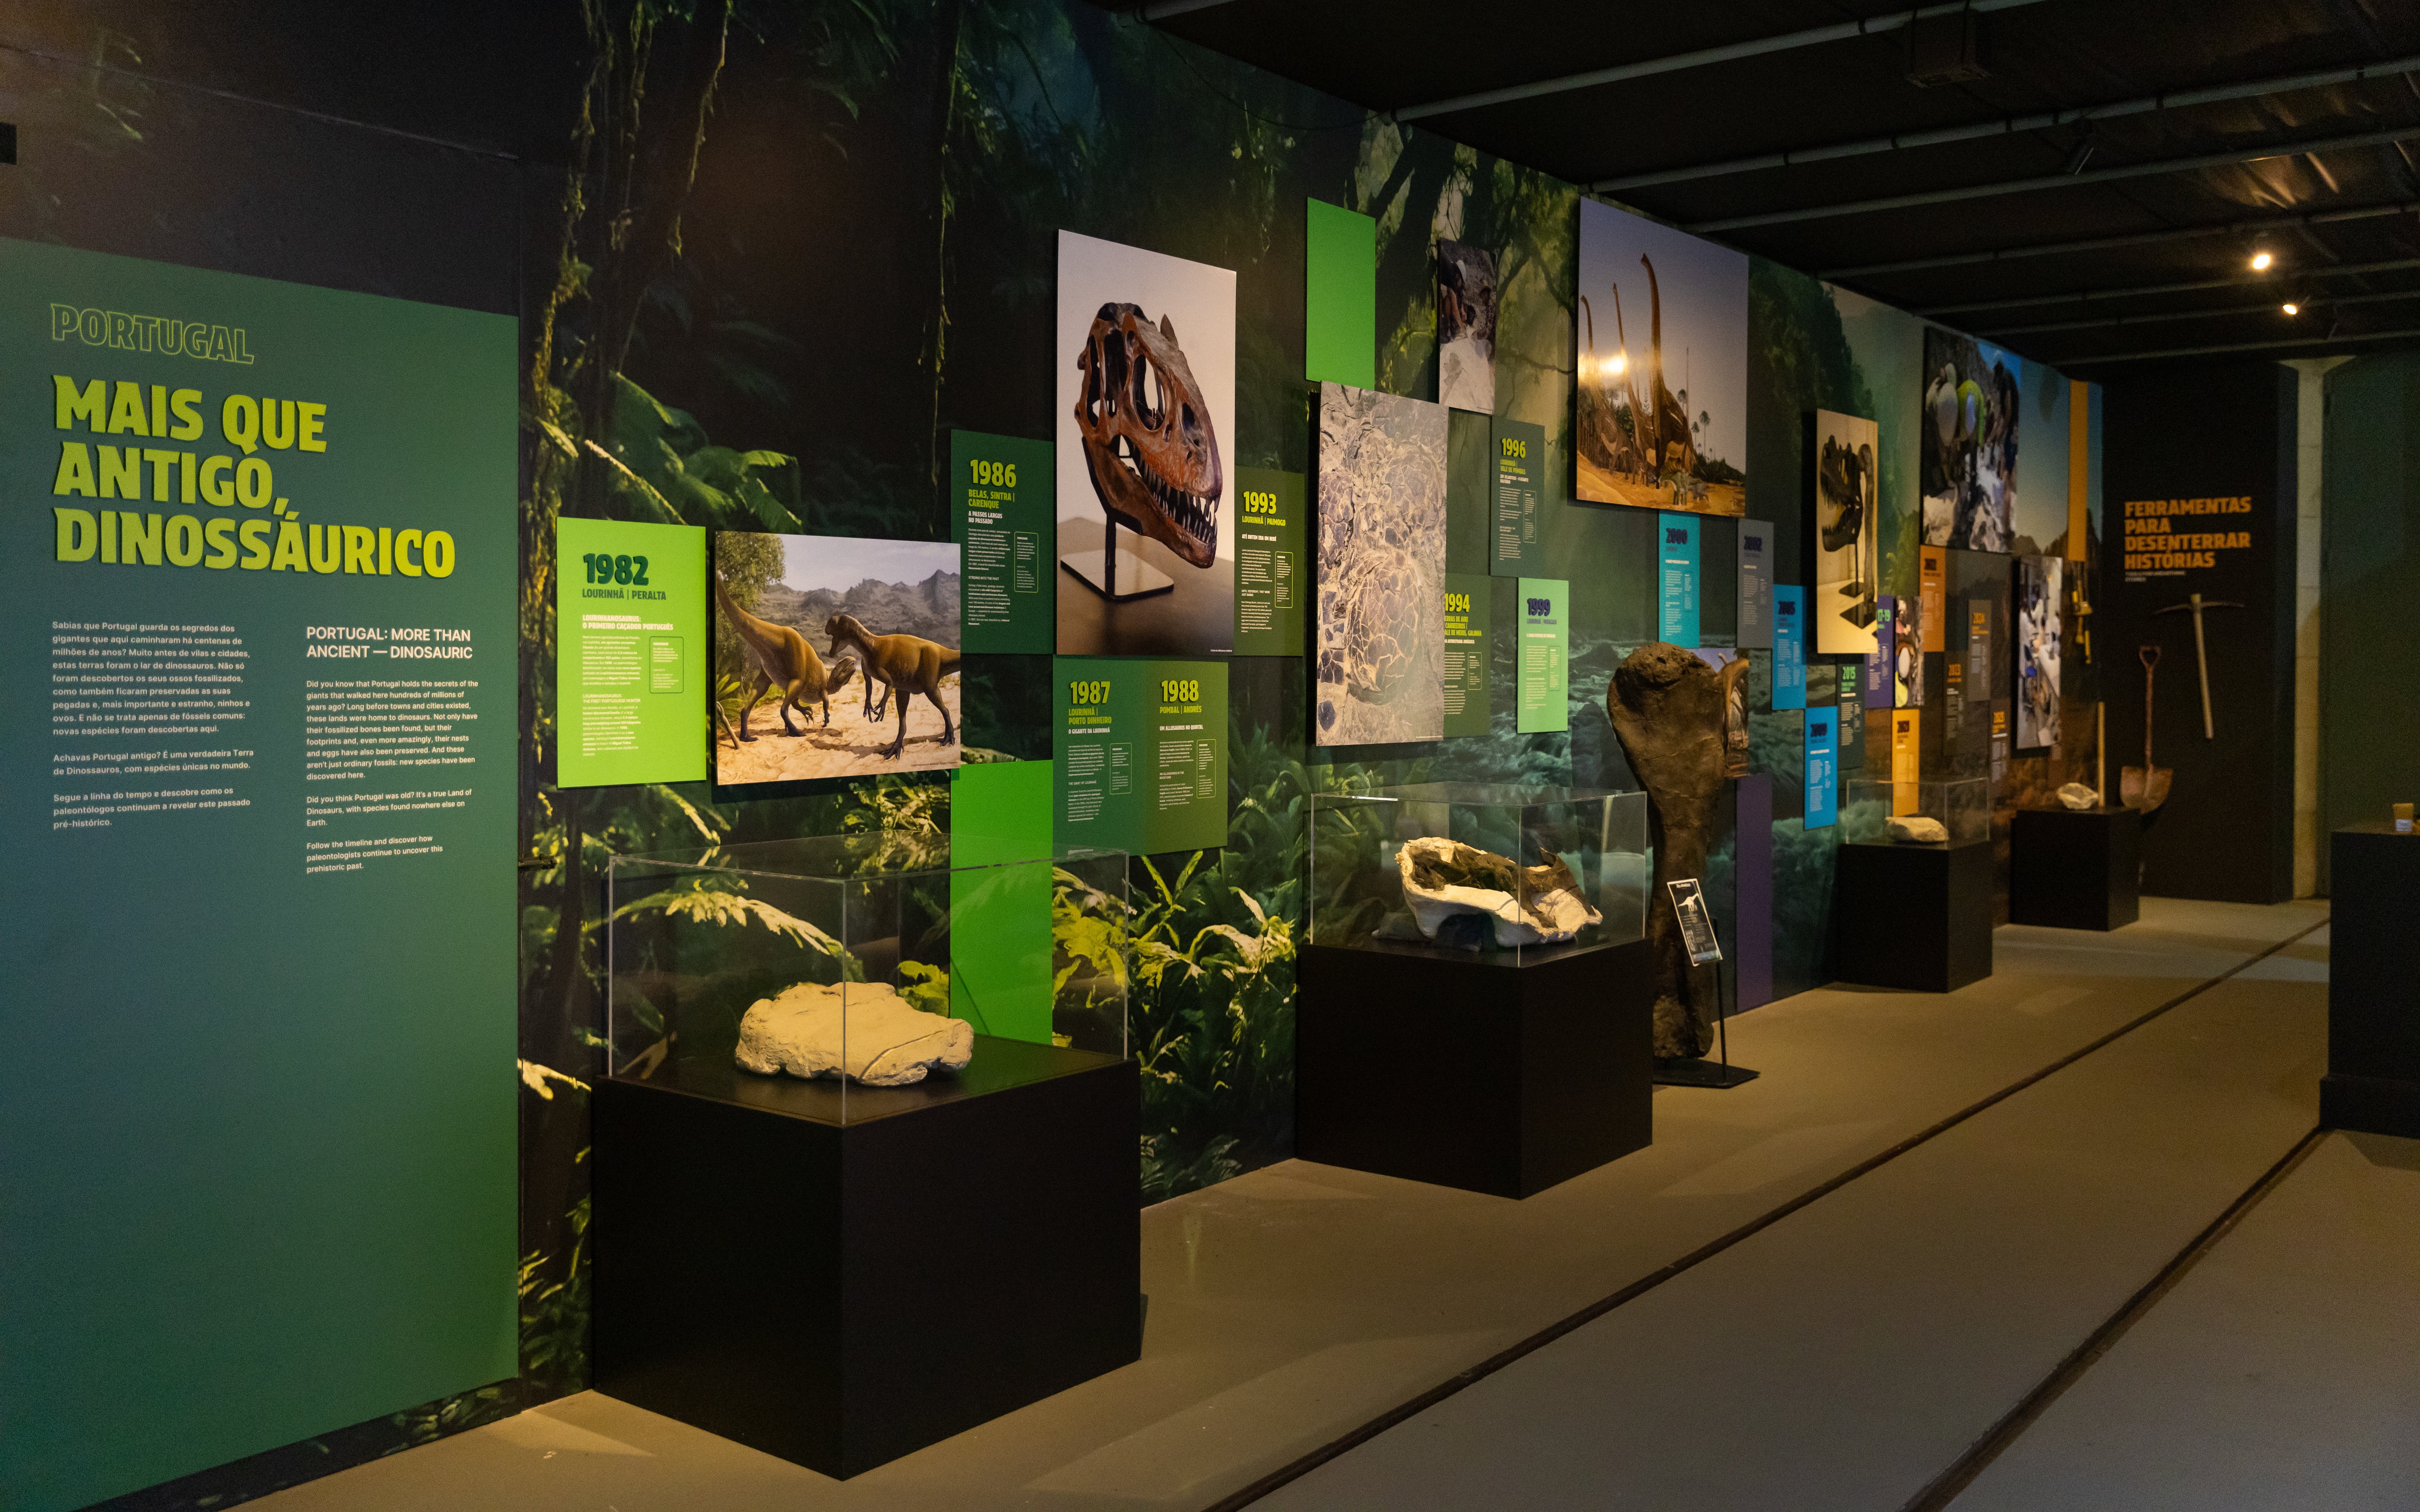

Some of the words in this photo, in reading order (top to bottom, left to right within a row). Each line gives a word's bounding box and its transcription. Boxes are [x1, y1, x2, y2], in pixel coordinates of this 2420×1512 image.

[50, 303, 255, 365] PORTUGAL
[54, 375, 203, 441] MAIS
[223, 394, 327, 453] QUE
[1502, 438, 1526, 458] 1996
[53, 442, 290, 516] ANTIGO,
[970, 459, 1017, 488] 1986
[968, 489, 989, 499] BELAS,
[990, 491, 1012, 501] SINTRA
[968, 498, 999, 509] CARENQUE
[1243, 491, 1277, 514] 1993
[2125, 496, 2251, 517] FERRAMENTAS
[1242, 516, 1264, 524] LOURINHÃ
[1267, 518, 1286, 526] PAIMOGO
[2125, 517, 2171, 534] PARA
[55, 508, 455, 578] DINOSSÁURICO
[2125, 532, 2250, 551] DESENTERRAR
[2125, 551, 2215, 569] HISTÓRIAS
[583, 553, 649, 586] 1982
[582, 588, 624, 599] LOURINHÃ
[632, 590, 666, 600] PERALTA
[1444, 593, 1470, 612] 1994
[1527, 598, 1551, 616] 1999
[102, 622, 137, 632] Portugal
[139, 624, 168, 632] guarda
[182, 625, 219, 633] segredos
[307, 626, 387, 640] PORTUGAL:
[391, 628, 430, 641] MORE
[433, 629, 471, 642] THAN
[52, 635, 90, 644] gigantes
[111, 636, 129, 644] aqui
[306, 645, 370, 658] ANCIENT
[390, 646, 473, 659] DINOSAURIC
[1070, 681, 1111, 704] 1987
[1161, 679, 1200, 702] 1988
[1068, 707, 1095, 716] LOURINHÃ
[1183, 704, 1202, 713] ANDRÉS
[1087, 716, 1112, 724] DINHEIRO
[54, 794, 81, 803] Segue
[161, 789, 199, 797] descobre
[53, 819, 112, 830] pré-histórico.
